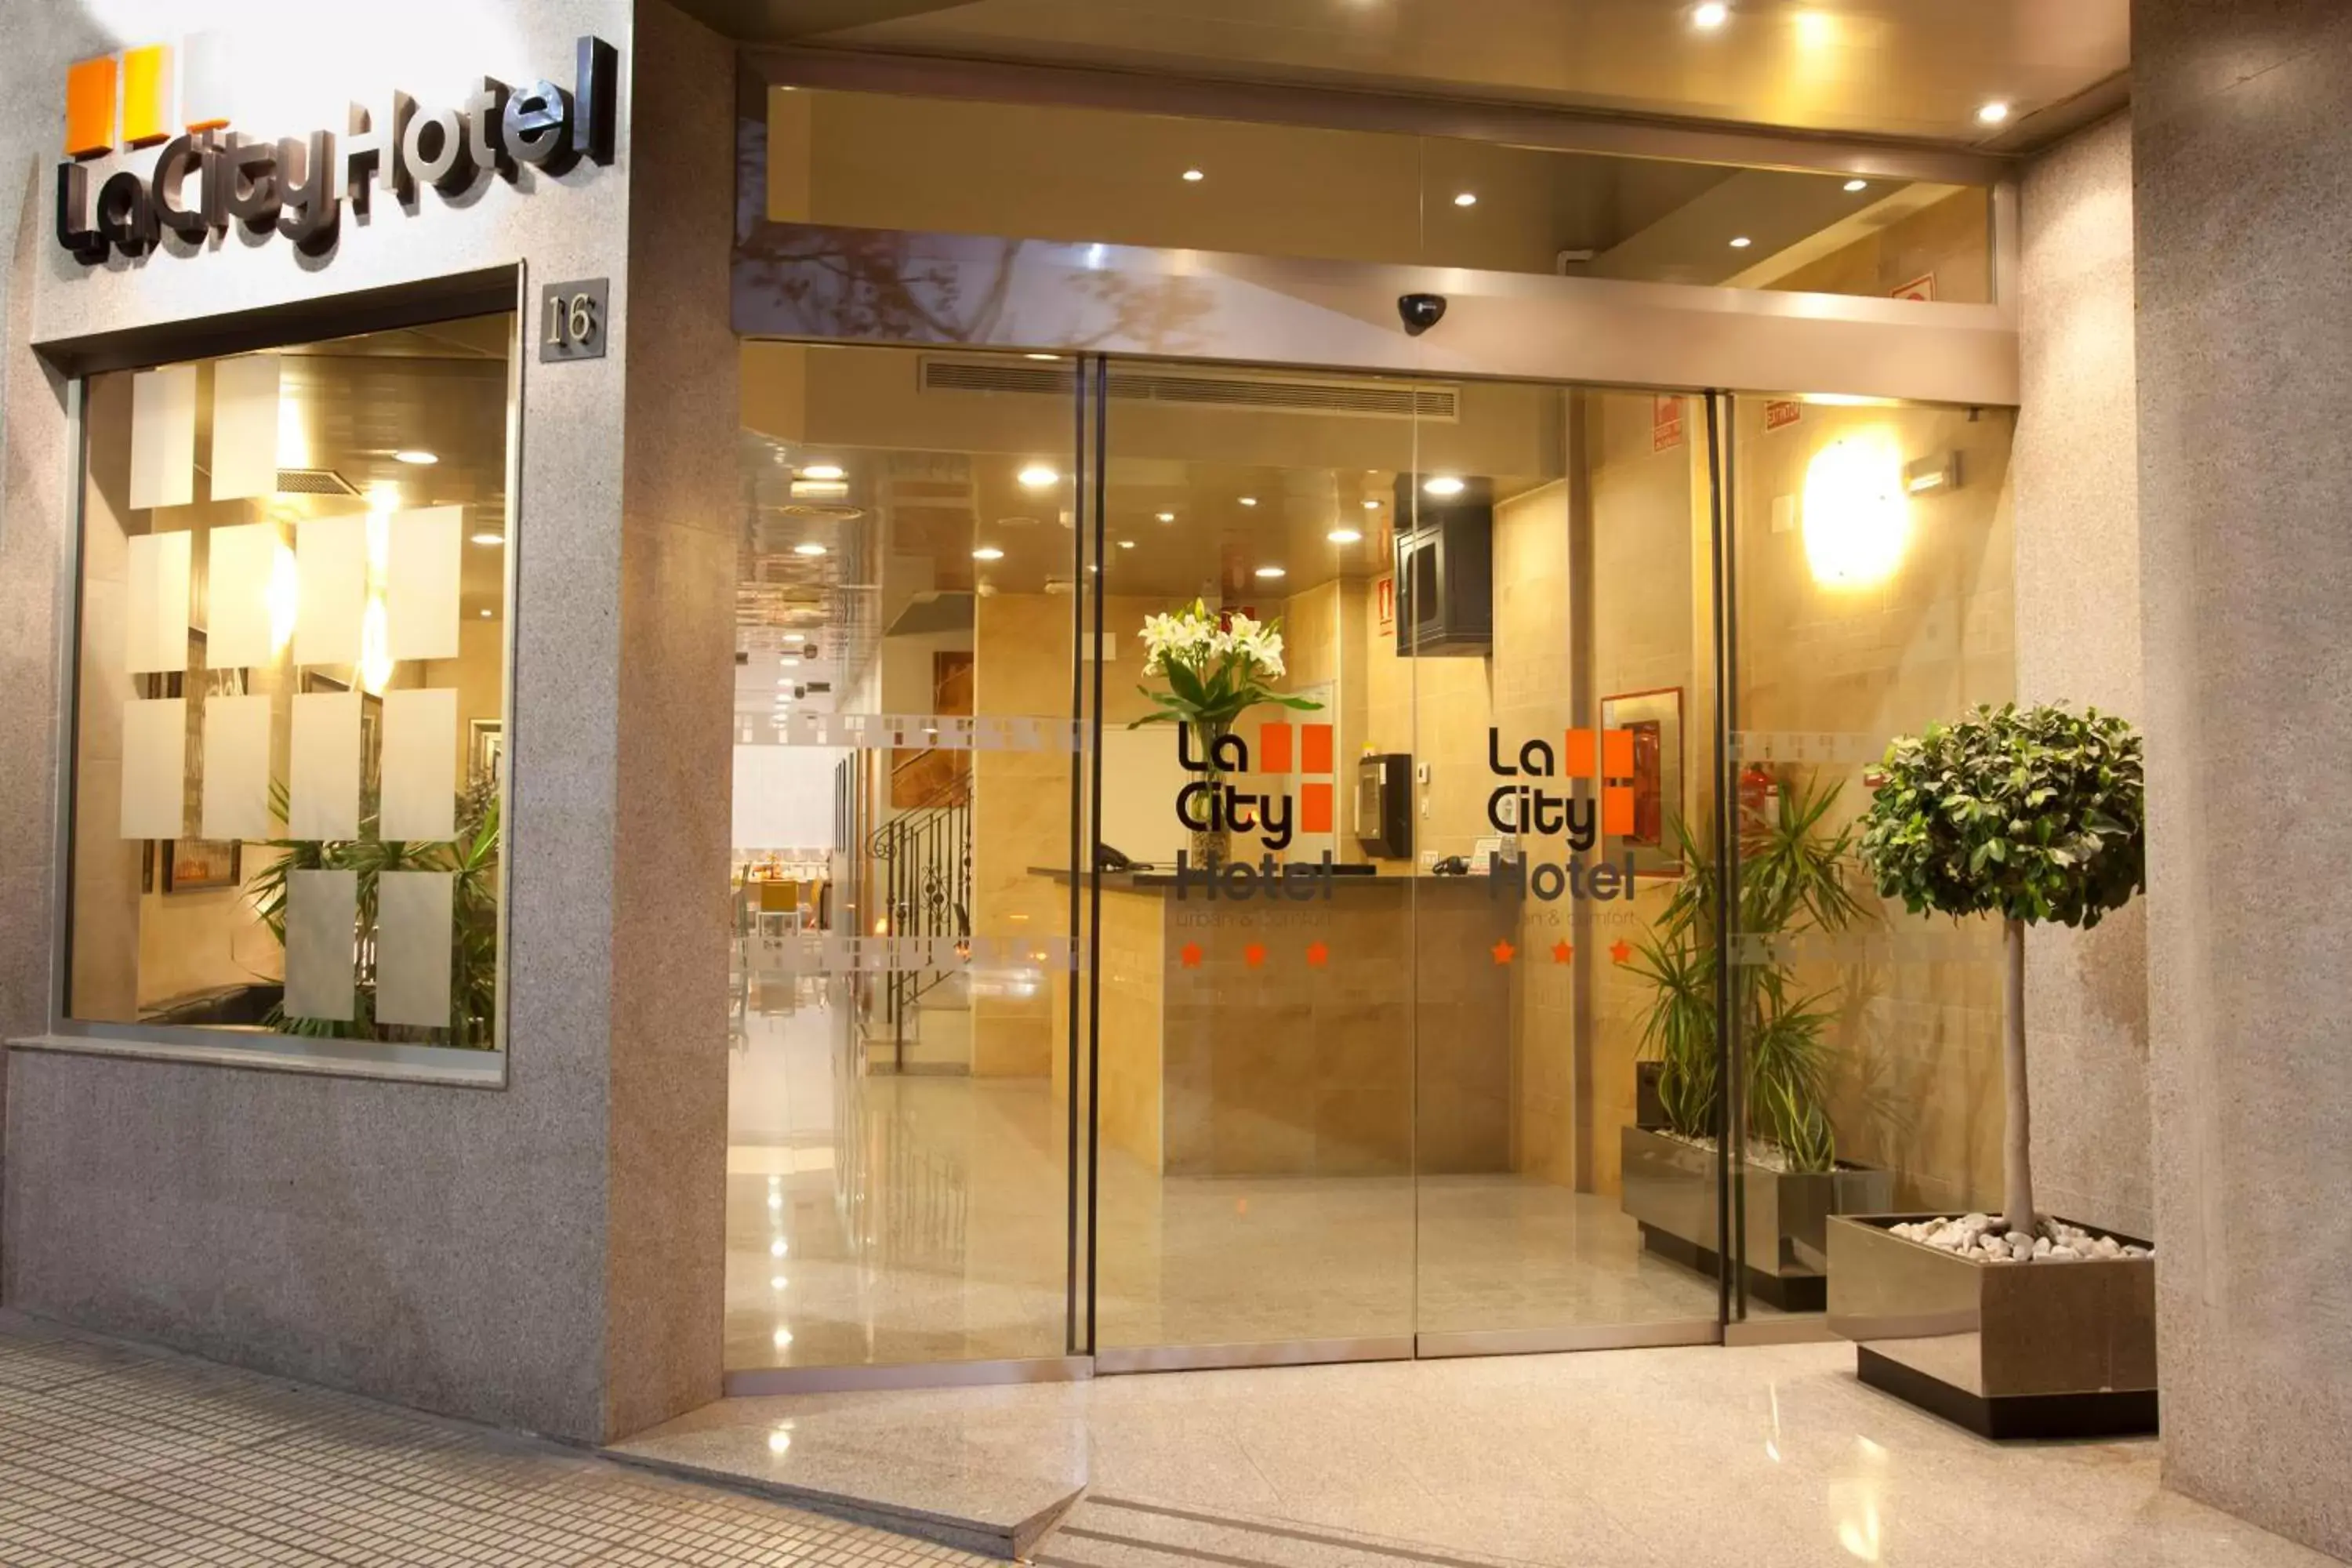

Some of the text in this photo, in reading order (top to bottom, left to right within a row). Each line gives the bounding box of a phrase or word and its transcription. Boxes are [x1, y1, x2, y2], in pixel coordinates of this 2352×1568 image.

[547, 291, 594, 347] 16
[1178, 720, 1248, 772] La
[1489, 727, 1554, 776] La
[1176, 781, 1292, 850] City
[1487, 786, 1595, 851] City
[1178, 849, 1332, 901] Hotel
[1490, 851, 1635, 902] Hotel
